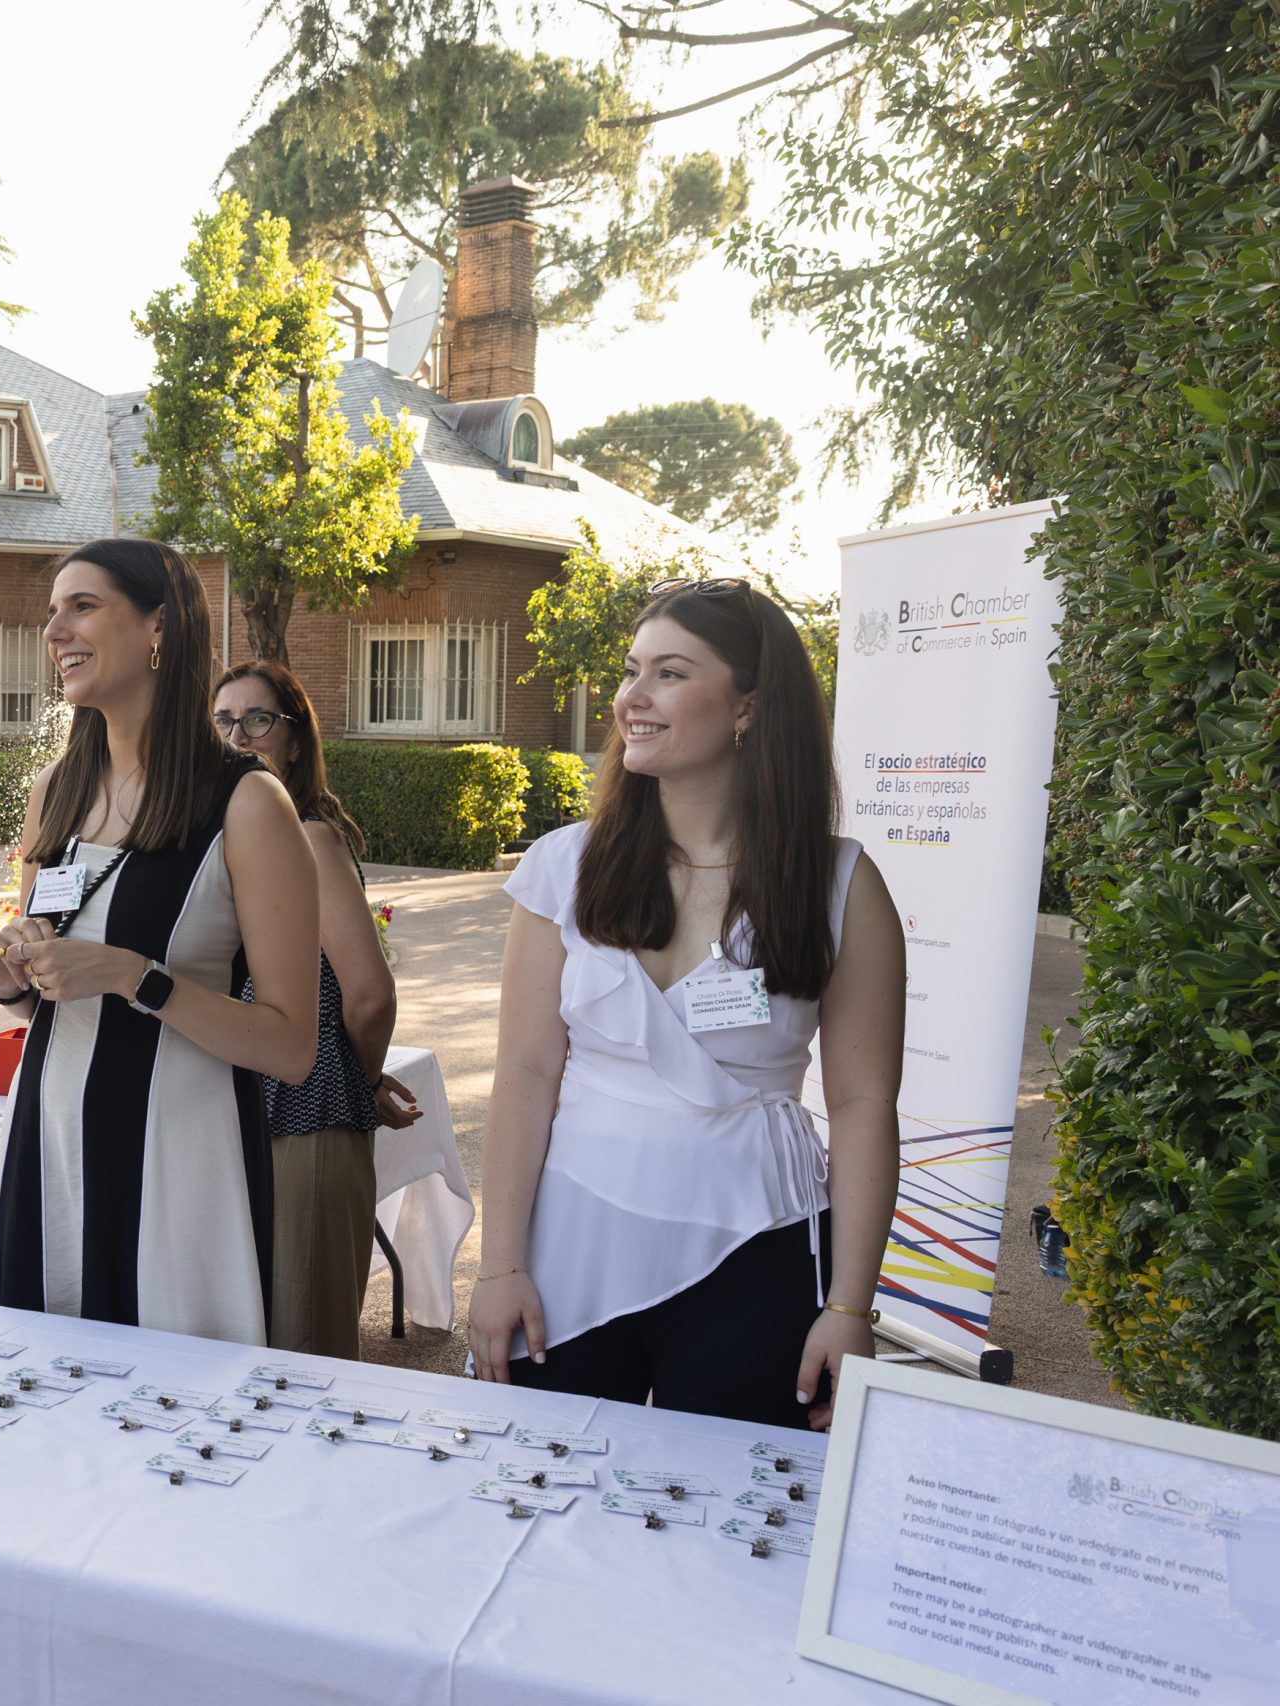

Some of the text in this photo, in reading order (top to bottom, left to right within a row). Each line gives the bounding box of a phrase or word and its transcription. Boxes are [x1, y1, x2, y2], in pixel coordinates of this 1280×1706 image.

[898, 586, 1031, 624] British Chamber
[896, 627, 1027, 654] of Commerce in Spain
[864, 752, 987, 772] El socio estratégico
[876, 776, 970, 797] de las empresas
[855, 799, 987, 822] británicas y españolas
[887, 825, 951, 845] en España
[693, 1006, 726, 1014] COMMERCE
[907, 1474, 1001, 1504] Aviso importante:
[1109, 1476, 1243, 1521] British Chamber
[904, 1493, 938, 1511] Puede
[941, 1503, 973, 1518] haber
[975, 1513, 990, 1524] un
[993, 1515, 1047, 1537] fotógrafo
[1048, 1530, 1057, 1541] y
[1059, 1533, 1074, 1544] un
[1146, 1555, 1161, 1567] en
[1164, 1559, 1176, 1570] el
[1122, 1503, 1186, 1528] Commerce
[1190, 1520, 1200, 1531] in
[1203, 1522, 1242, 1542] Spain
[899, 1527, 946, 1548] nuestras
[948, 1540, 992, 1559] cuentas
[994, 1551, 1010, 1563] de
[1012, 1555, 1044, 1573] redes
[902, 1512, 1200, 1595] y podríamos publicar su trabajo en el sitio web y en
[894, 1562, 987, 1596] Important notice:
[886, 1616, 1059, 1676] and our social media accounts.
[889, 1601, 1201, 1698] event, and we may publish their work on the website
[892, 1581, 1213, 1682] There may be a photographer and videographer at the
